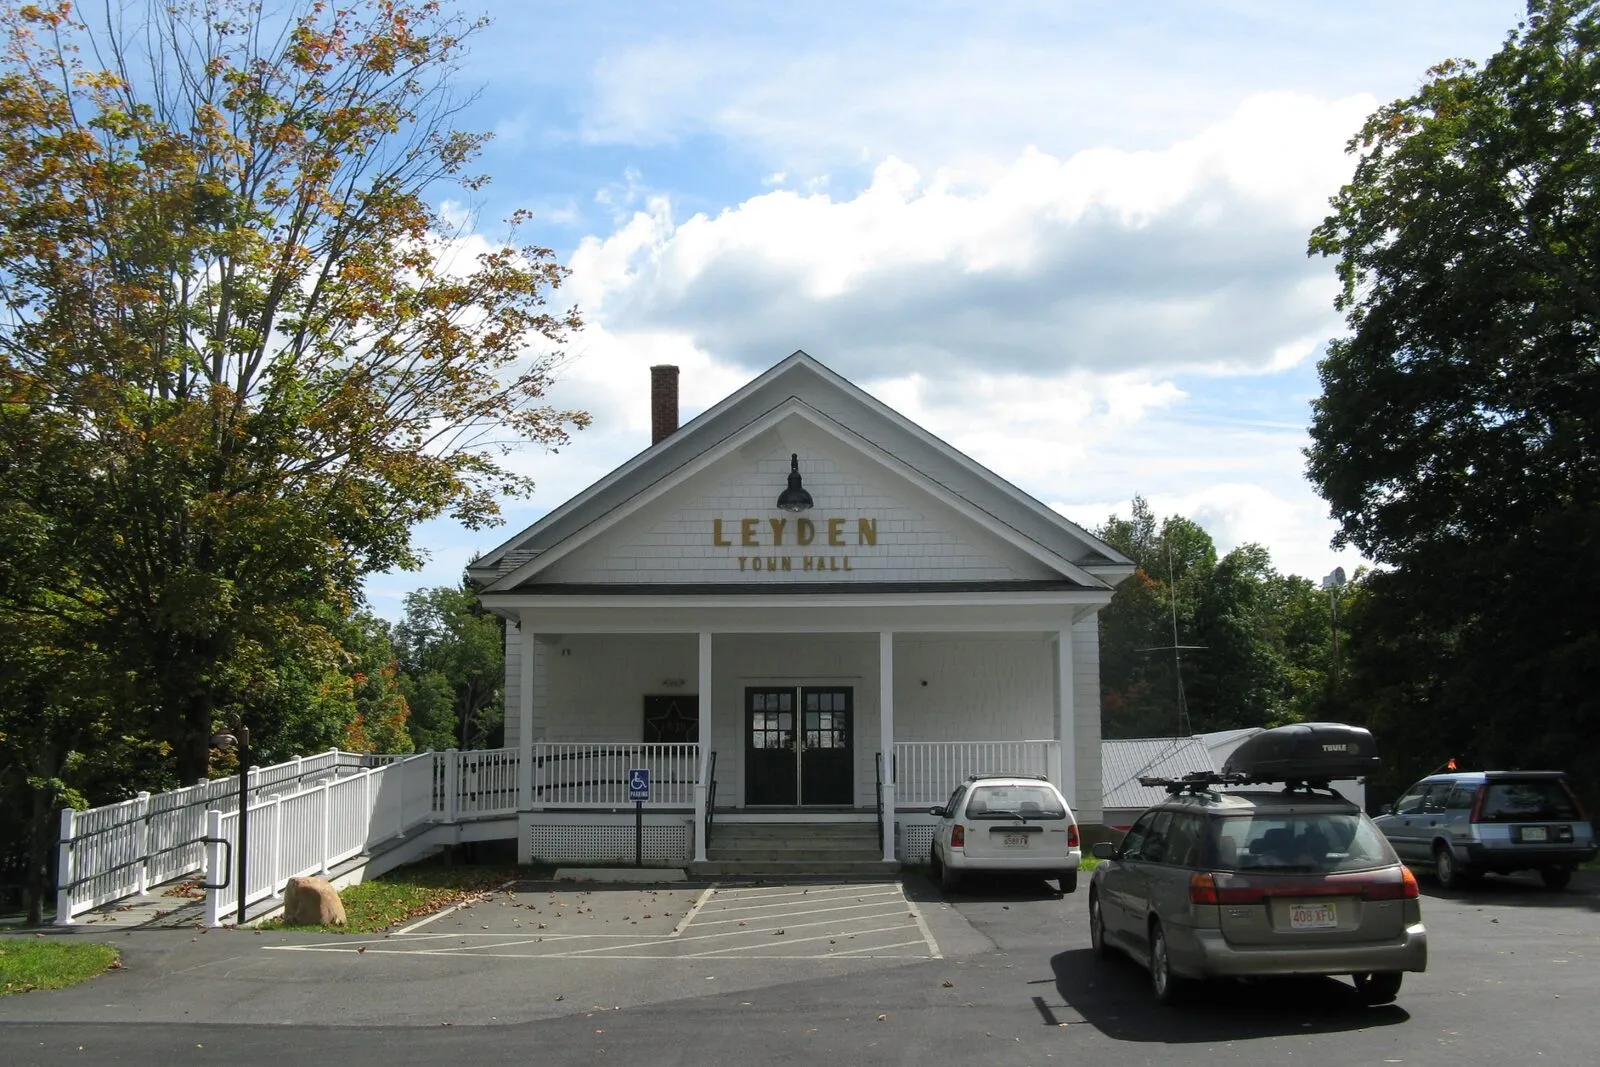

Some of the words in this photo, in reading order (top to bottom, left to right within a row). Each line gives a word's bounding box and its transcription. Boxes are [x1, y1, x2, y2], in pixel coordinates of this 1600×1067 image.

[713, 518, 877, 547] LEYDEN
[738, 556, 791, 572] TOWN
[803, 555, 853, 572] HALL
[1321, 744, 1347, 752] THULE
